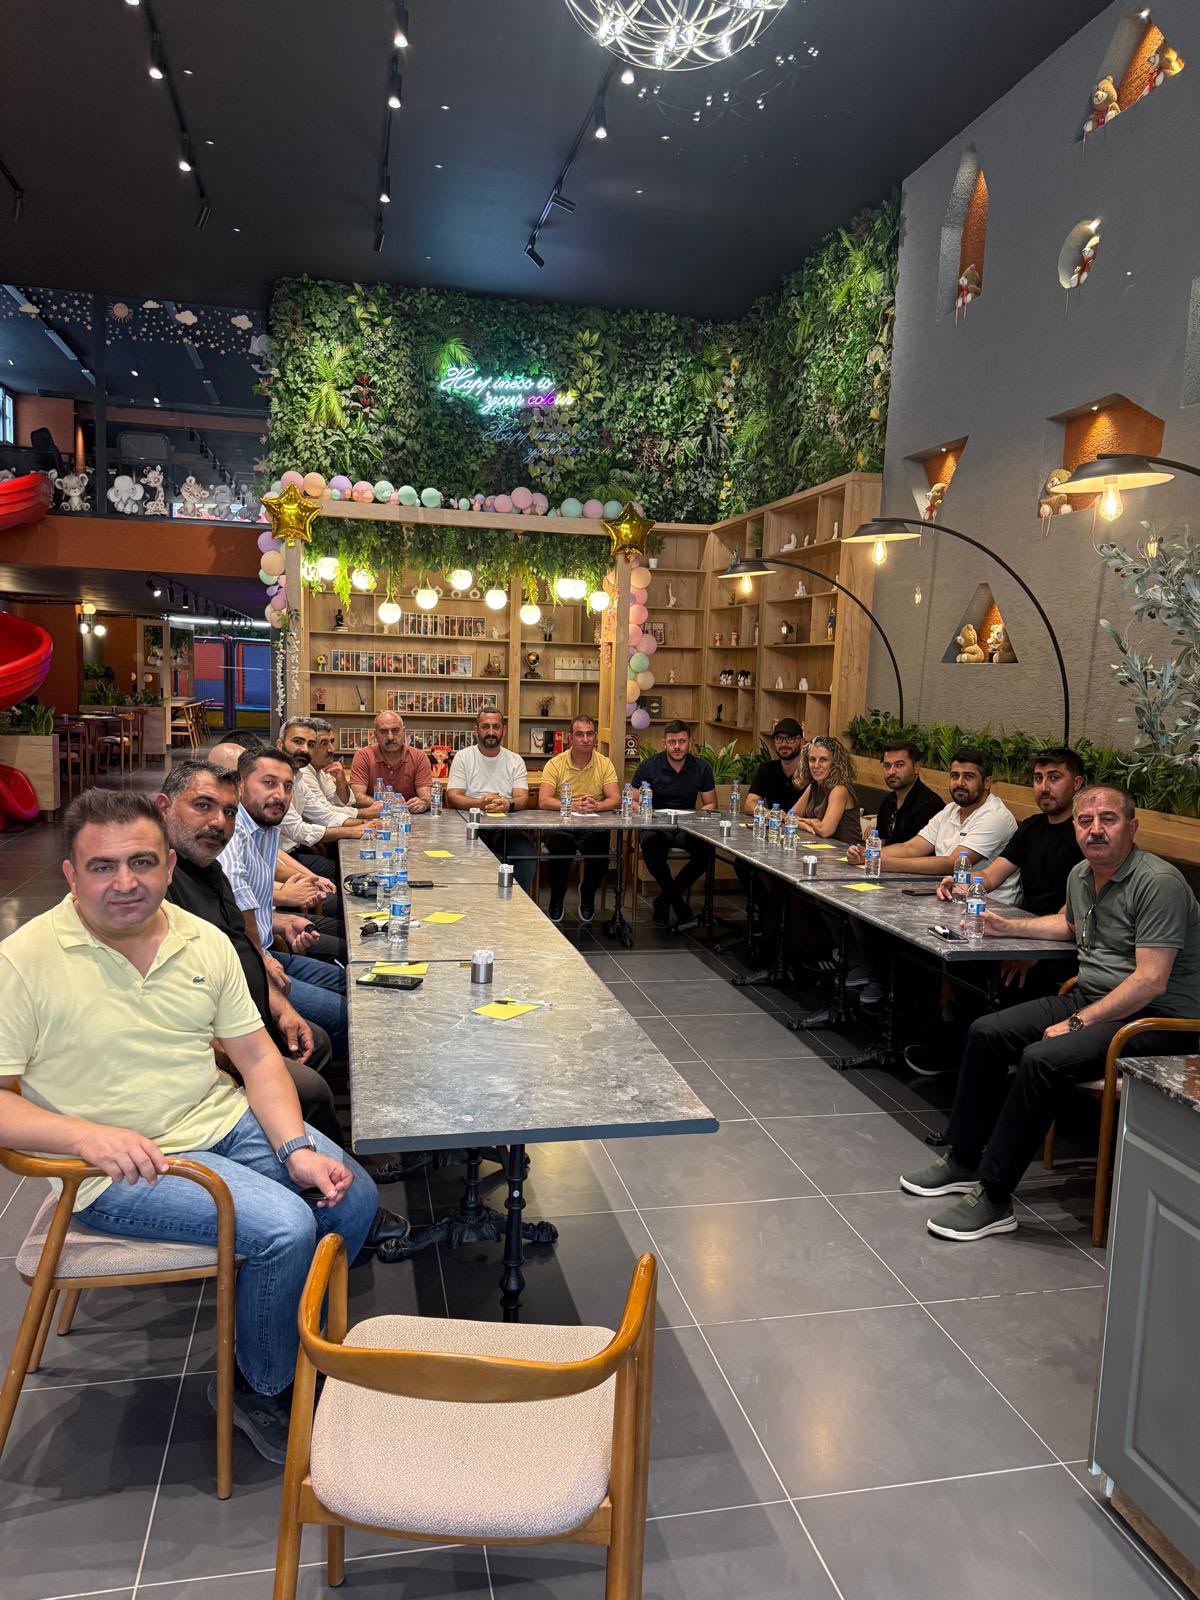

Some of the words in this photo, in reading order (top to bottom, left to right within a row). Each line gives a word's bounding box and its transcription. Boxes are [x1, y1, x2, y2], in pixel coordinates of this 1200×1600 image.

[440, 367, 534, 396] Happiness
[537, 377, 553, 389] is
[480, 390, 524, 414] your
[527, 387, 574, 405] colour
